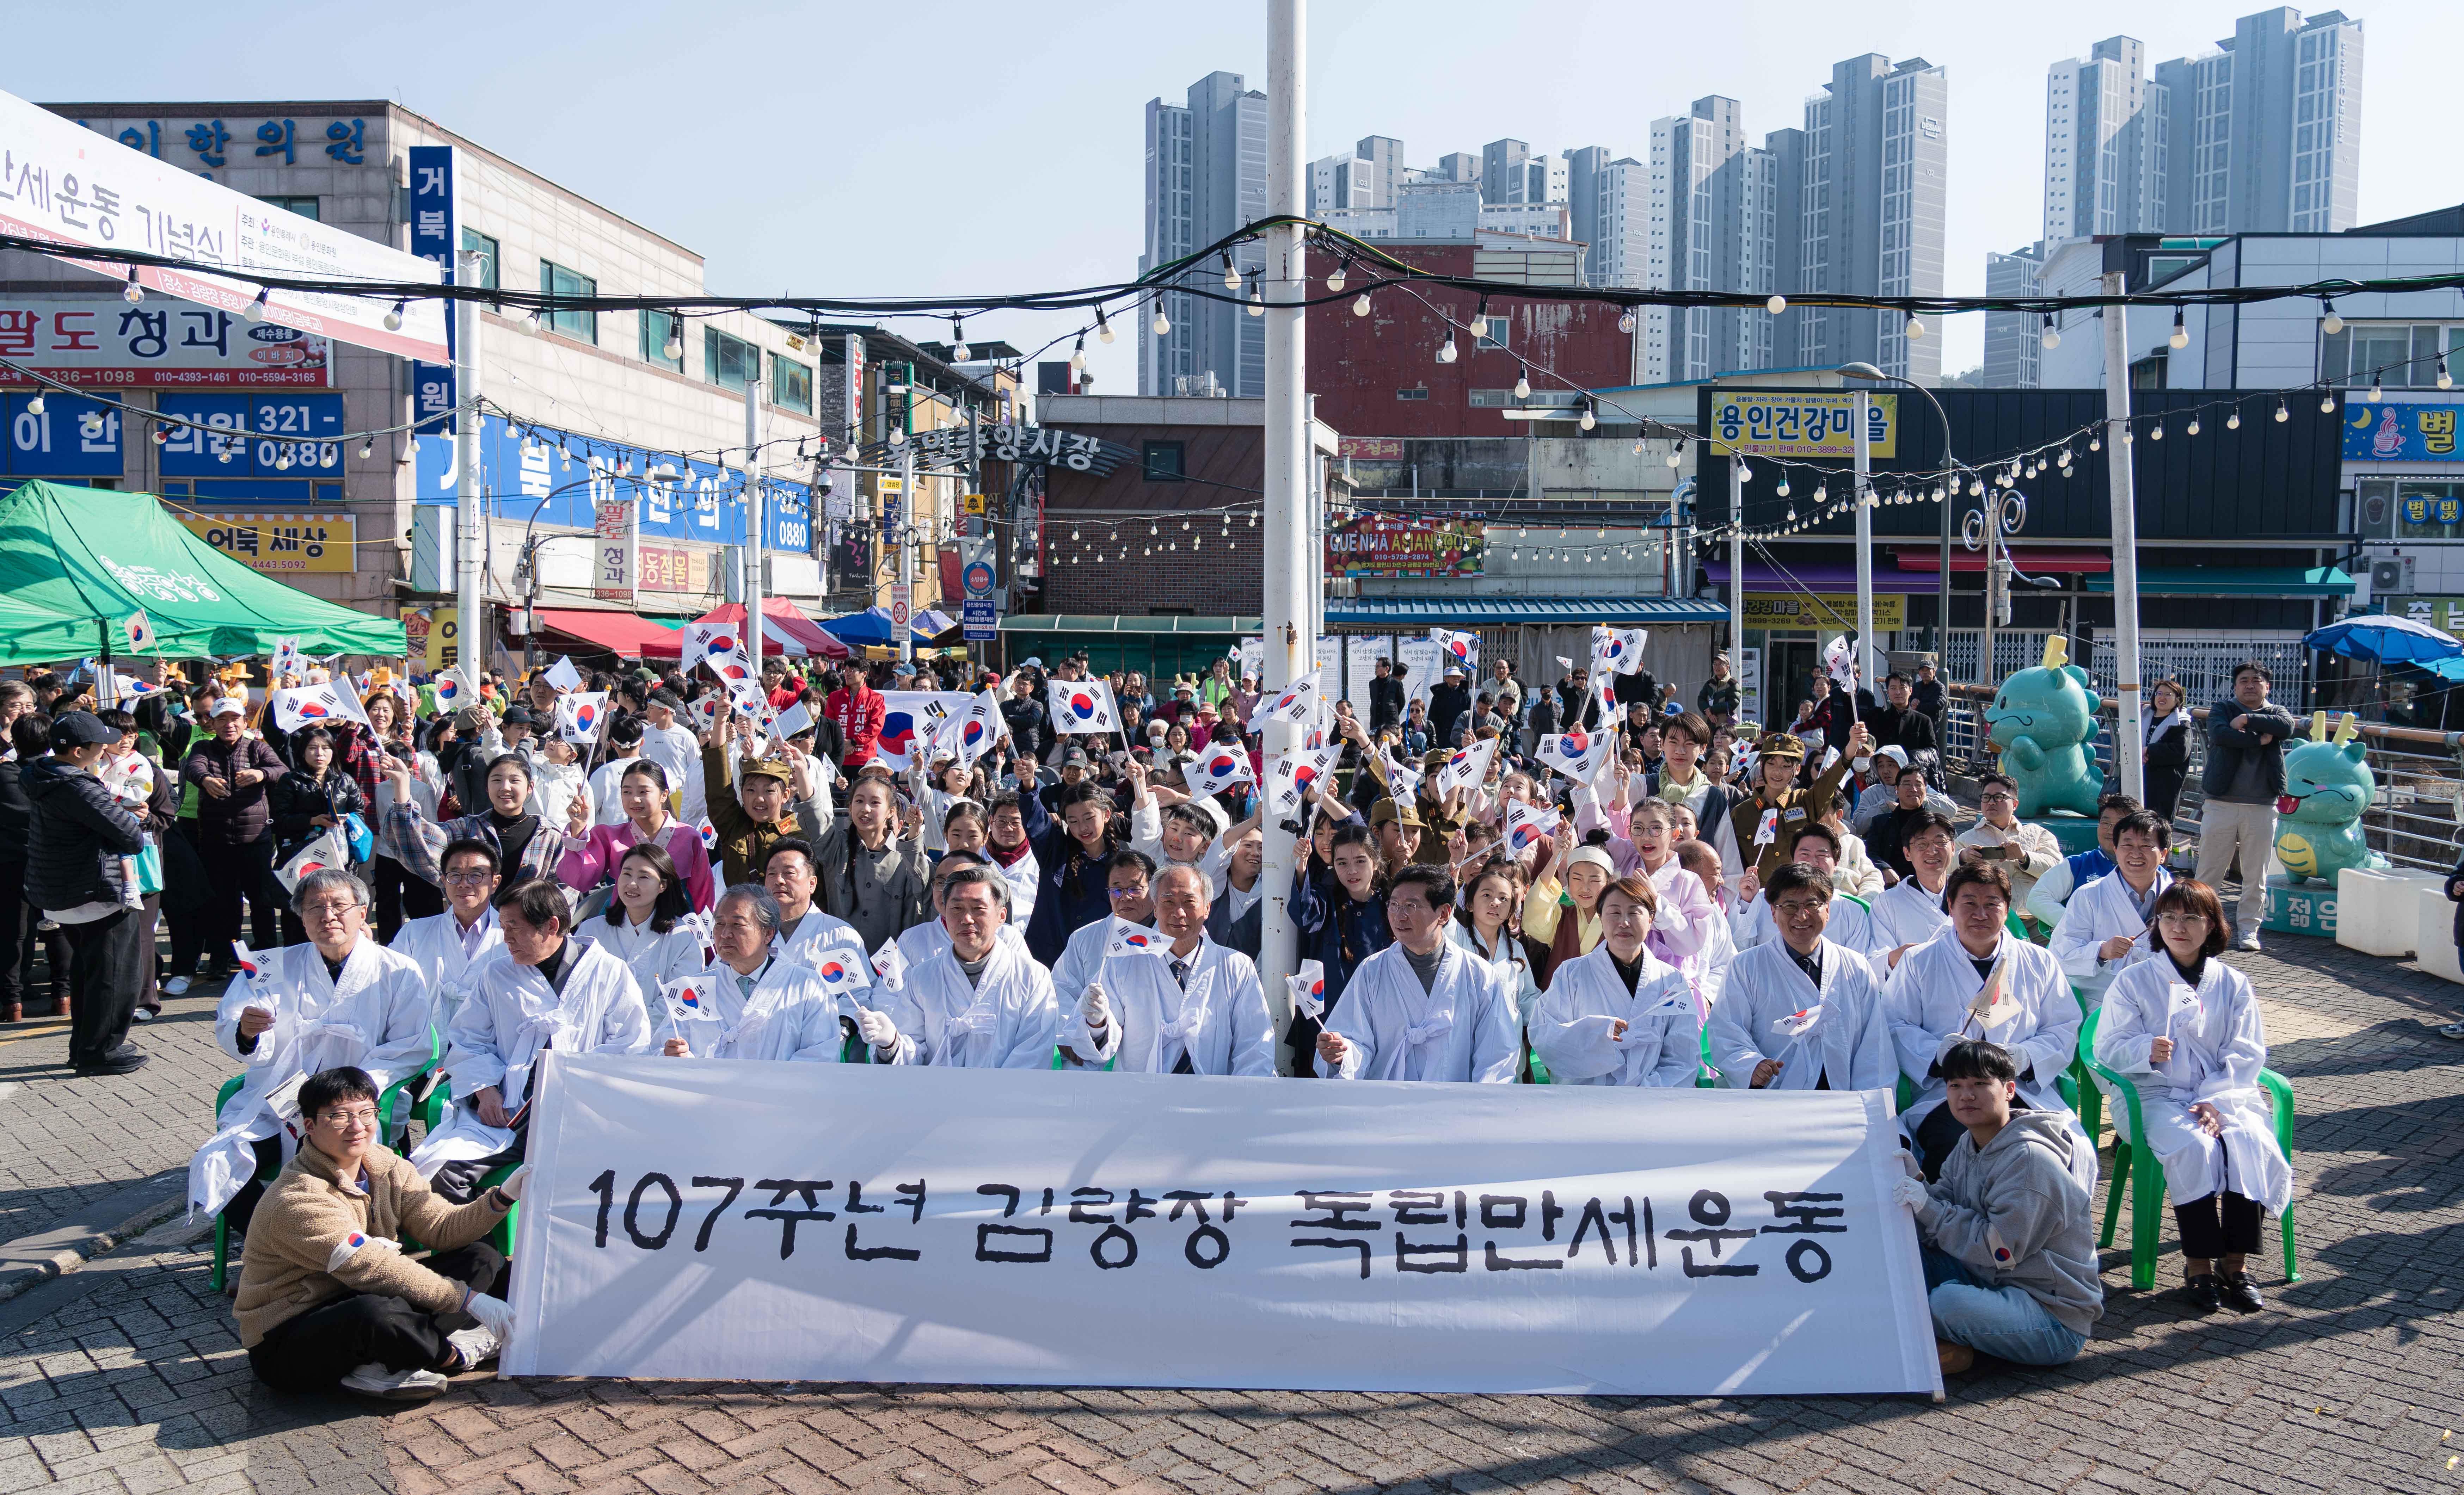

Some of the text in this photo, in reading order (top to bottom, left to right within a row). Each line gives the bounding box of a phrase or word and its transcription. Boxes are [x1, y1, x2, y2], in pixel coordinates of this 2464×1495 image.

[1922, 121, 1940, 133] DESIAN
[78, 118, 365, 168] 이한의원
[1926, 168, 1934, 178] 102
[136, 205, 224, 275] 기념식
[241, 235, 254, 249] 주관
[259, 241, 290, 262] 용인문화원
[242, 214, 254, 229] 주최
[271, 226, 296, 243] 용인특례시
[311, 240, 336, 258] 용인문화원
[242, 257, 254, 271] 후원
[189, 281, 219, 304] 김량장
[263, 304, 323, 333] 이마당(금북교)
[0, 307, 233, 358] 팔도 청과
[256, 328, 293, 340] 제수용품
[155, 372, 230, 382] 010-4393-1461
[239, 372, 315, 382] 010-5594-3165
[1717, 405, 1888, 442] 용인건강마을
[2418, 410, 2457, 455] 별
[258, 441, 338, 467] 0880
[886, 425, 1100, 470] 용인중앙시장
[1338, 443, 1401, 456] 앙 청과
[1744, 445, 1855, 453] 민물고기 판매 010-3899-326
[207, 527, 327, 558] 어묵 세상
[779, 520, 806, 548] 0880
[1330, 532, 1473, 552] QUE NHA ASIAN FOOD
[604, 547, 626, 584] 청과
[596, 590, 632, 598] 336-1098
[2288, 897, 2337, 931] 젊은
[589, 1169, 1848, 1284] 107주년 김량장 독립만세운동
